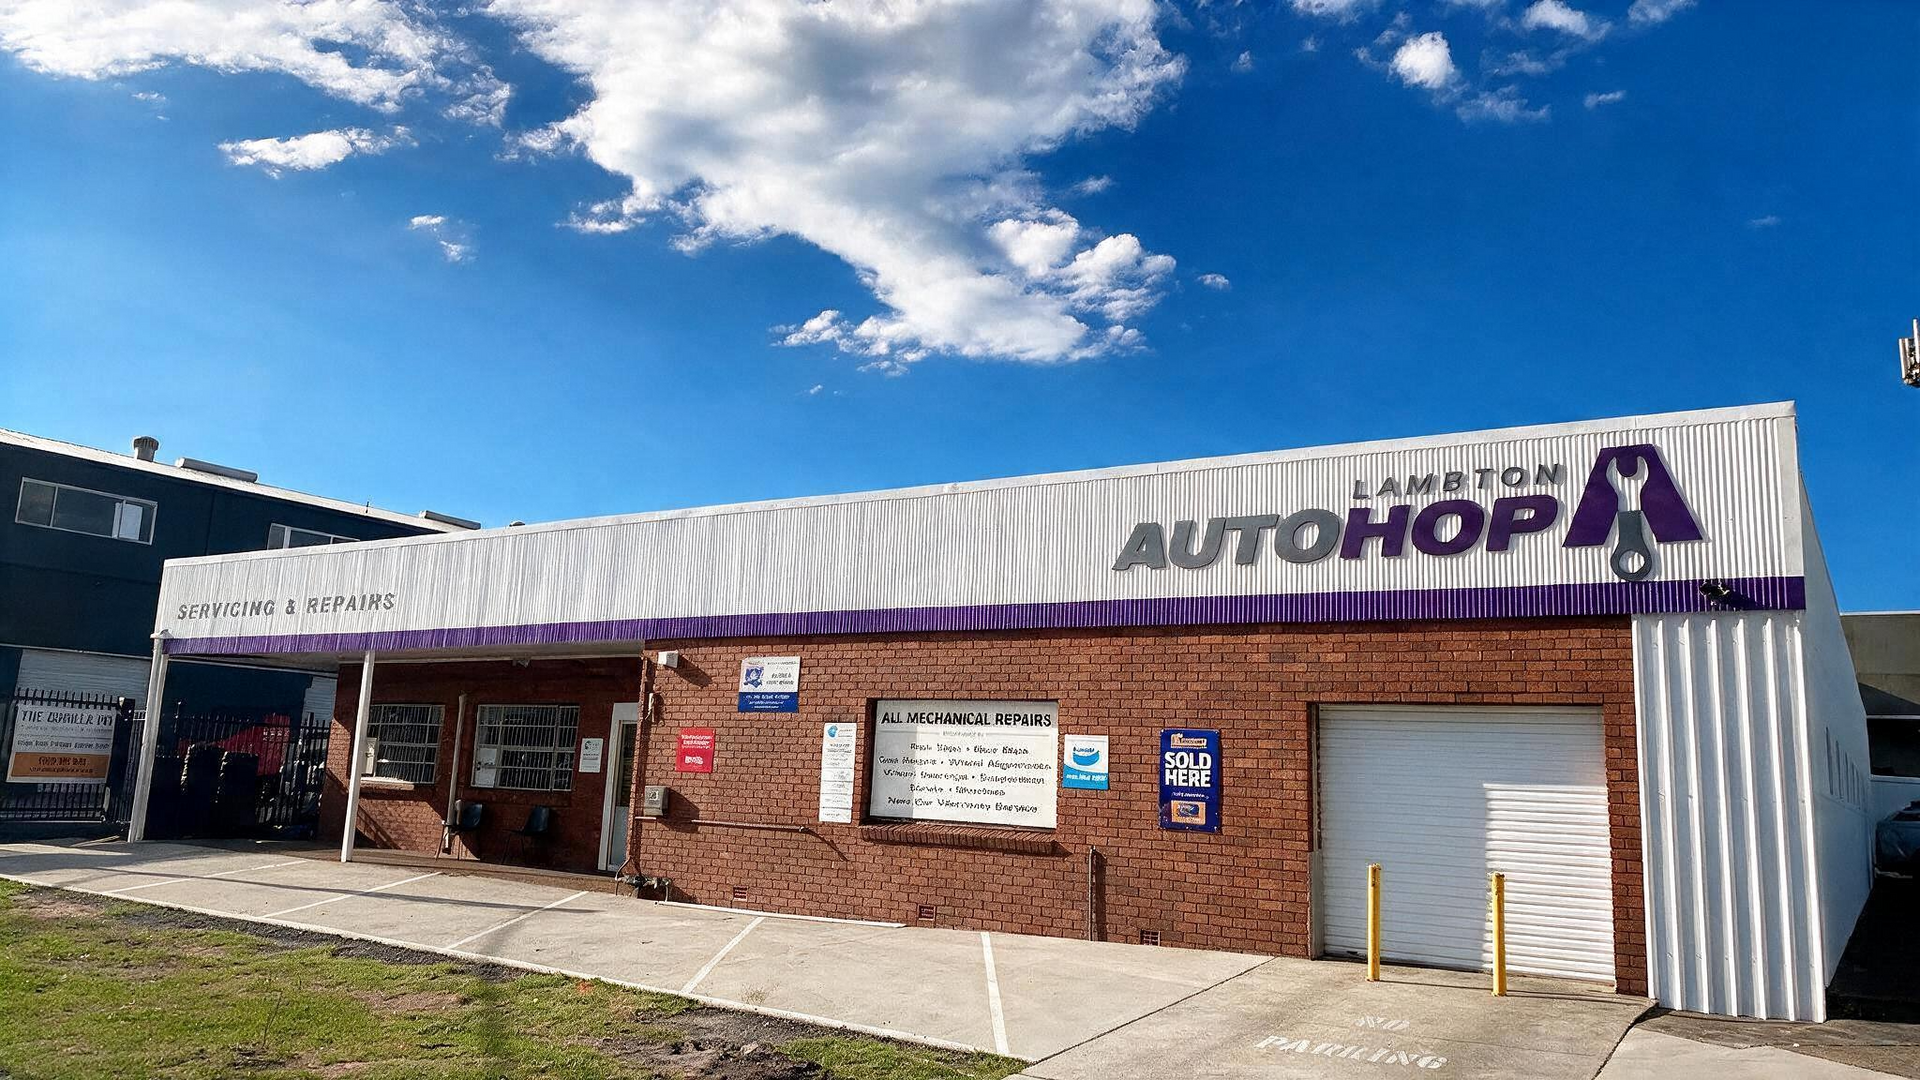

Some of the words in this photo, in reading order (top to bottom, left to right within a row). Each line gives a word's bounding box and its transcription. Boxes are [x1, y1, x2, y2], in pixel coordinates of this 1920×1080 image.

[1353, 464, 1560, 499] LAMBTON
[177, 599, 276, 620] SERVICING
[285, 599, 297, 615] &
[306, 592, 396, 614] REPAIRS
[881, 711, 901, 724] ALL
[906, 711, 991, 726] MECHANICAL
[995, 713, 1052, 727] REPAIRS
[1164, 751, 1212, 770] SOLD
[1164, 769, 1212, 788] HERE
[1254, 1035, 1449, 1069] PARKING
